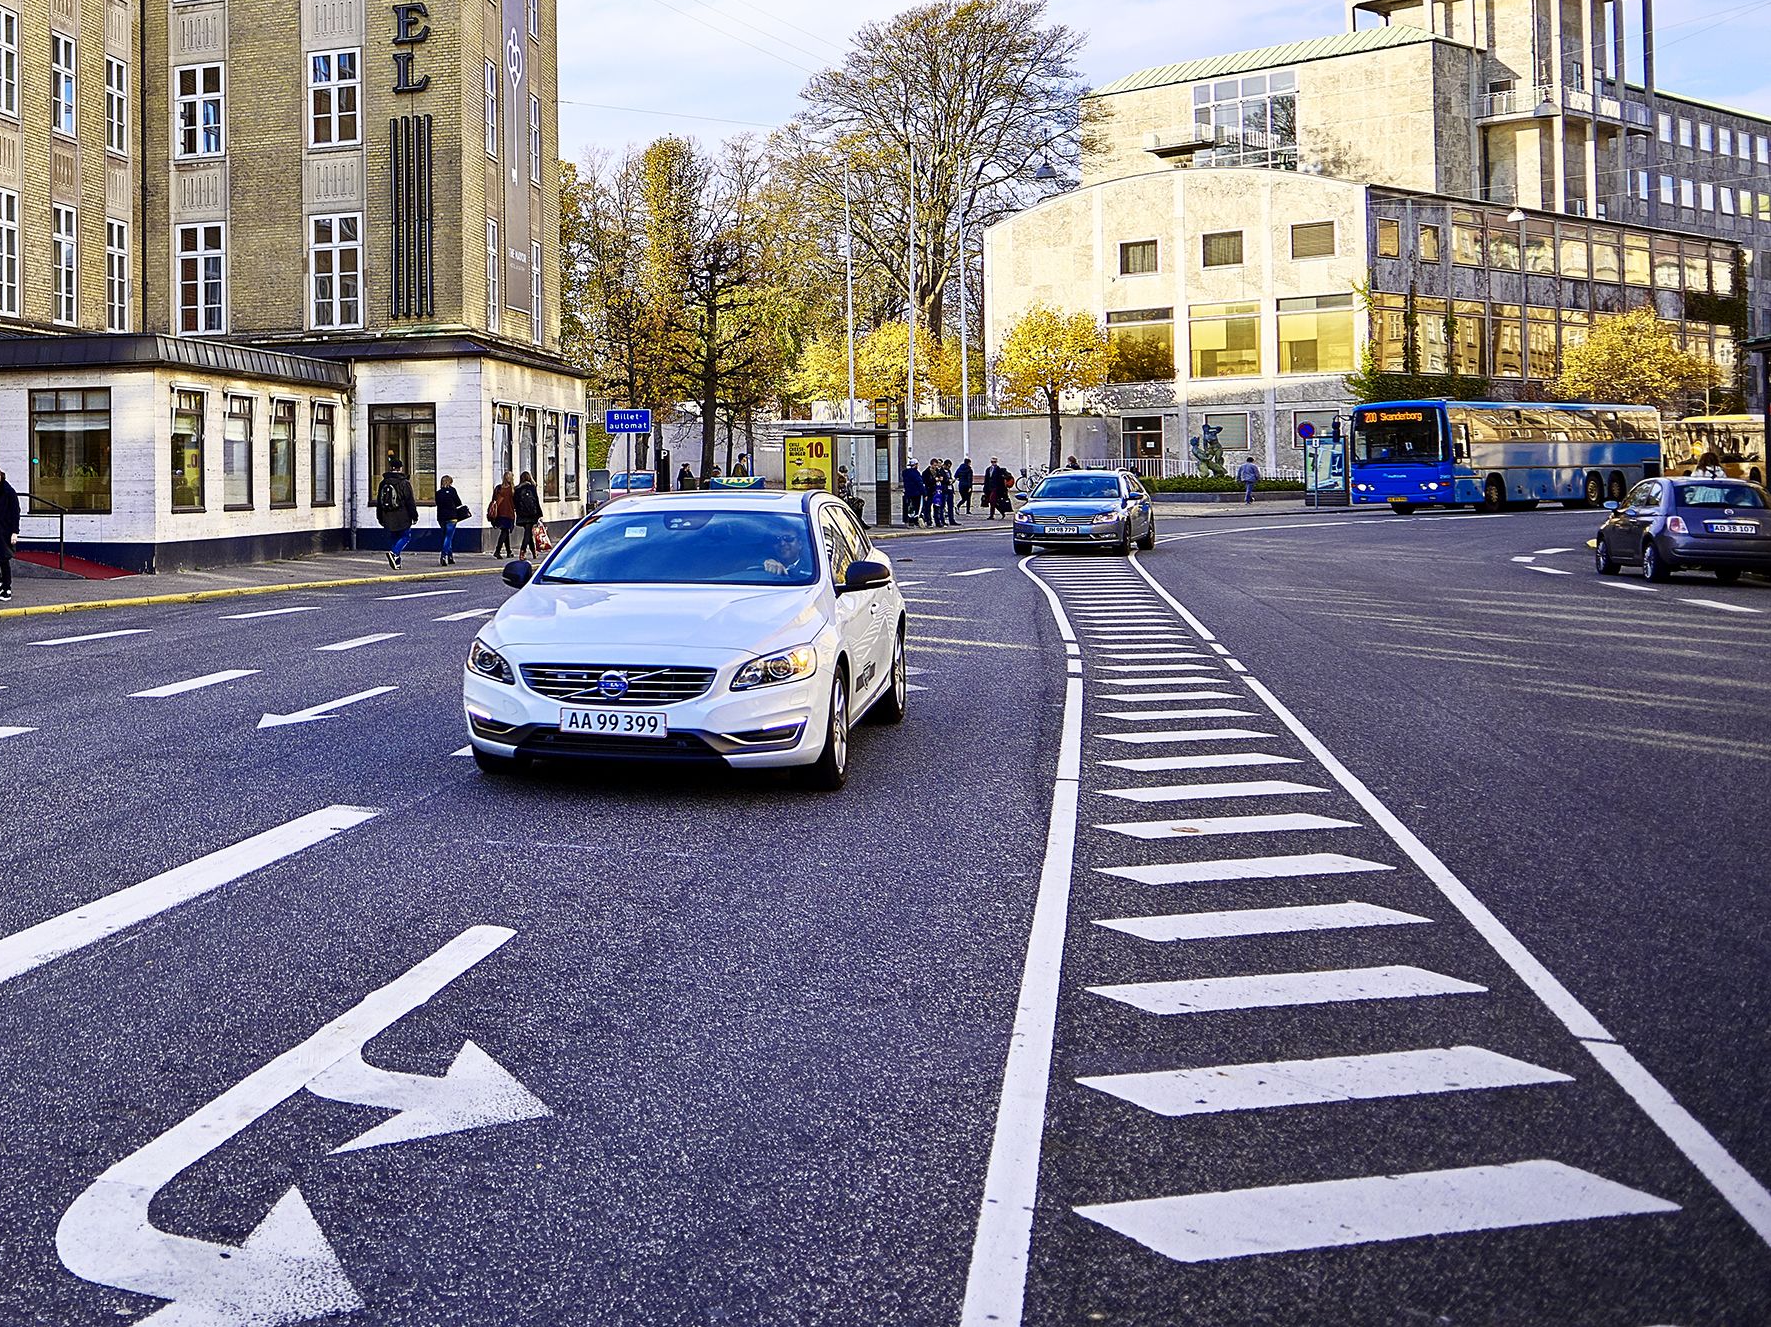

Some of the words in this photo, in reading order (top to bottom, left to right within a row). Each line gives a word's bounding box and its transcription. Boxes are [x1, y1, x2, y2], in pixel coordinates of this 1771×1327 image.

[1364, 412, 1378, 423] 200
[1379, 412, 1423, 422] Skanderborg
[609, 422, 647, 430] automat
[661, 450, 668, 460] P
[806, 441, 824, 459] 10
[722, 477, 755, 485] TAXI
[568, 712, 593, 729] AA
[596, 713, 619, 731] 99
[623, 714, 658, 734] 399
